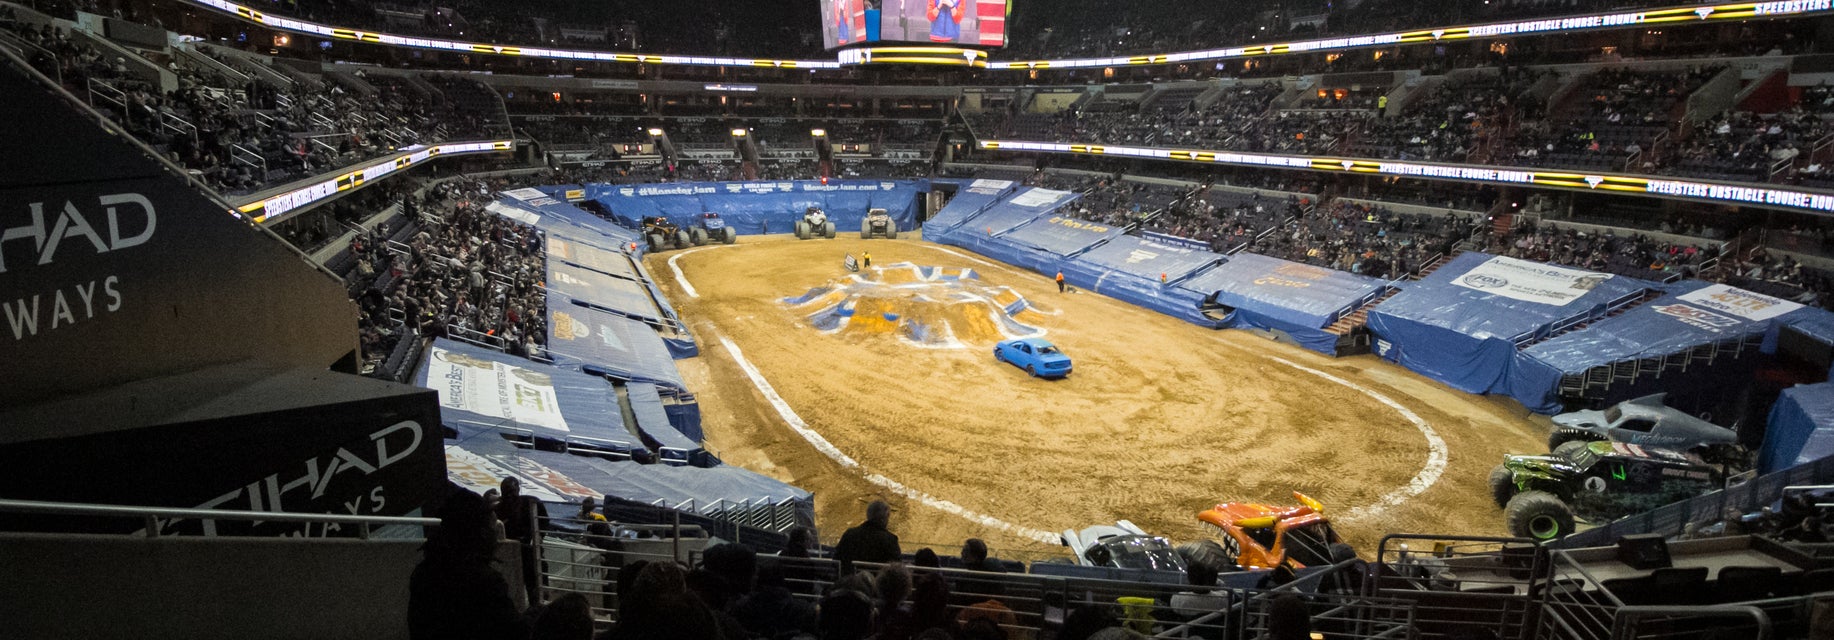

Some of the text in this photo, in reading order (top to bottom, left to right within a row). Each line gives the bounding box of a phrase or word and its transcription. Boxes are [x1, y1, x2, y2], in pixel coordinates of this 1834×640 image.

[1754, 0, 1829, 15] SPEEDSTERS
[1468, 23, 1517, 36] SPEEDSTERS
[1518, 20, 1561, 32] OBSTACLE
[1562, 16, 1602, 29] COURSE:
[1603, 13, 1637, 26] ROUND
[1379, 162, 1421, 174] SPEEDSTERS
[1422, 165, 1459, 177] OBSTACLE
[1461, 167, 1495, 180] COURSE:
[1497, 170, 1527, 182] ROUND
[1647, 180, 1707, 197] SPEEDSTERS
[1709, 185, 1763, 202] OBSTACLE
[1766, 190, 1809, 207] COURSE:
[3, 275, 121, 340] WAYS
